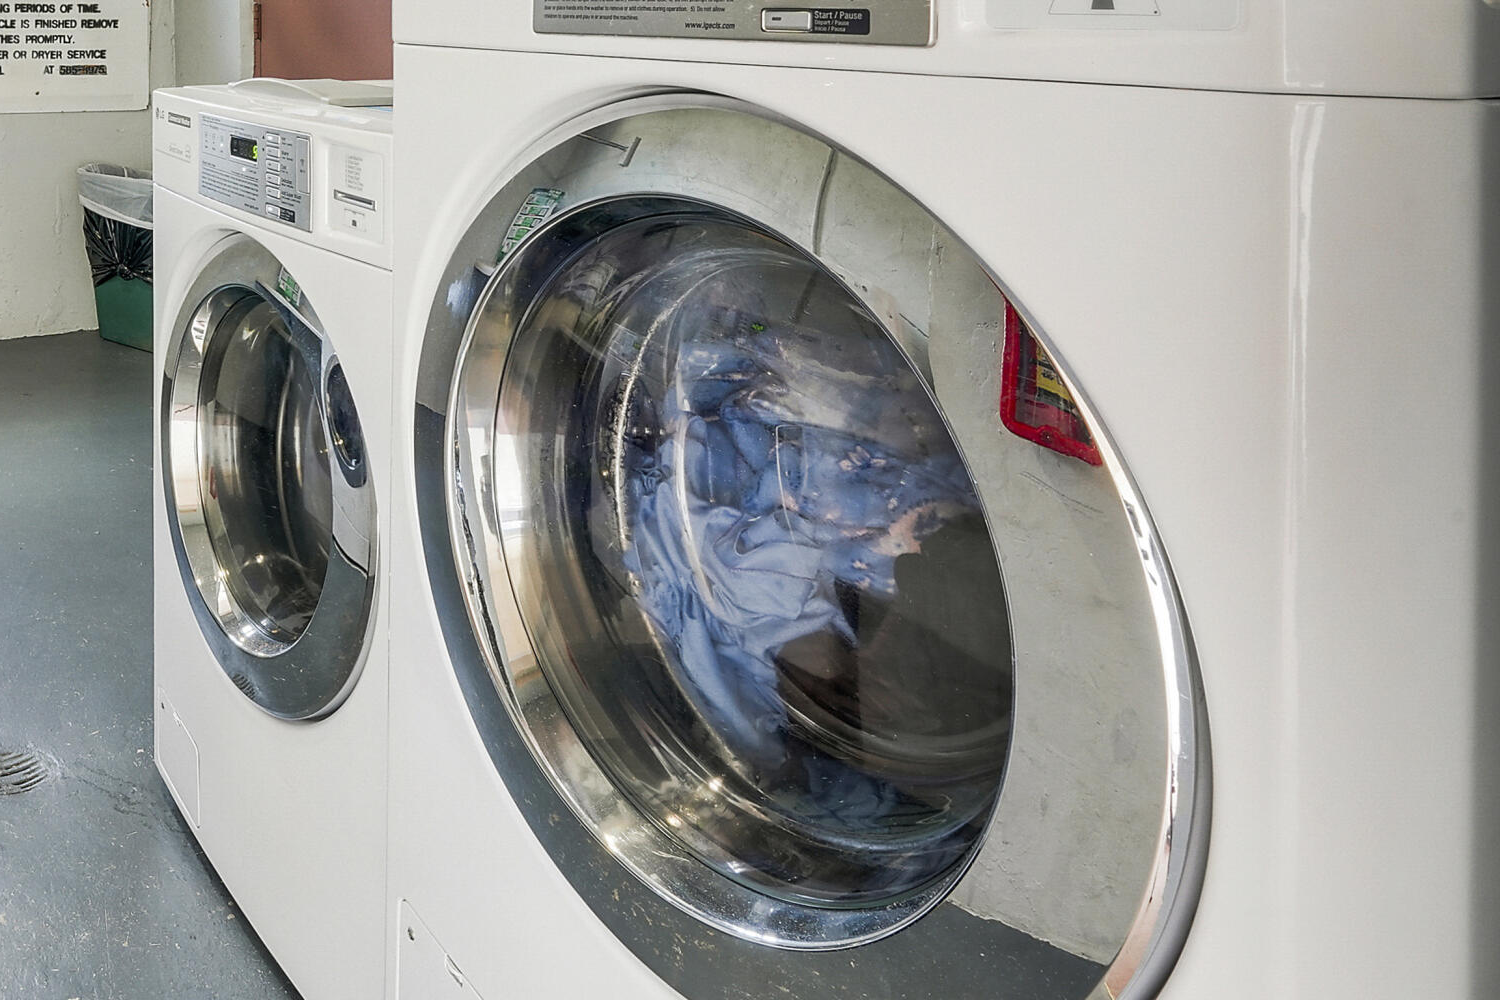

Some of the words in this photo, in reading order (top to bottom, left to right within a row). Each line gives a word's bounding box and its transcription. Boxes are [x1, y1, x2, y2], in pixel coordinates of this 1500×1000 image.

[15, 4, 55, 13] PERIODS
[60, 4, 73, 13] OF
[814, 11, 832, 19] Start
[21, 20, 29, 28] IS
[35, 20, 77, 28] FINISHED
[81, 19, 118, 28] REMOVE
[26, 35, 75, 44] PROMPTLY.
[13, 50, 27, 59] OR
[32, 50, 62, 59] DRYER
[67, 50, 106, 59] SERVICE
[44, 66, 54, 74] AT
